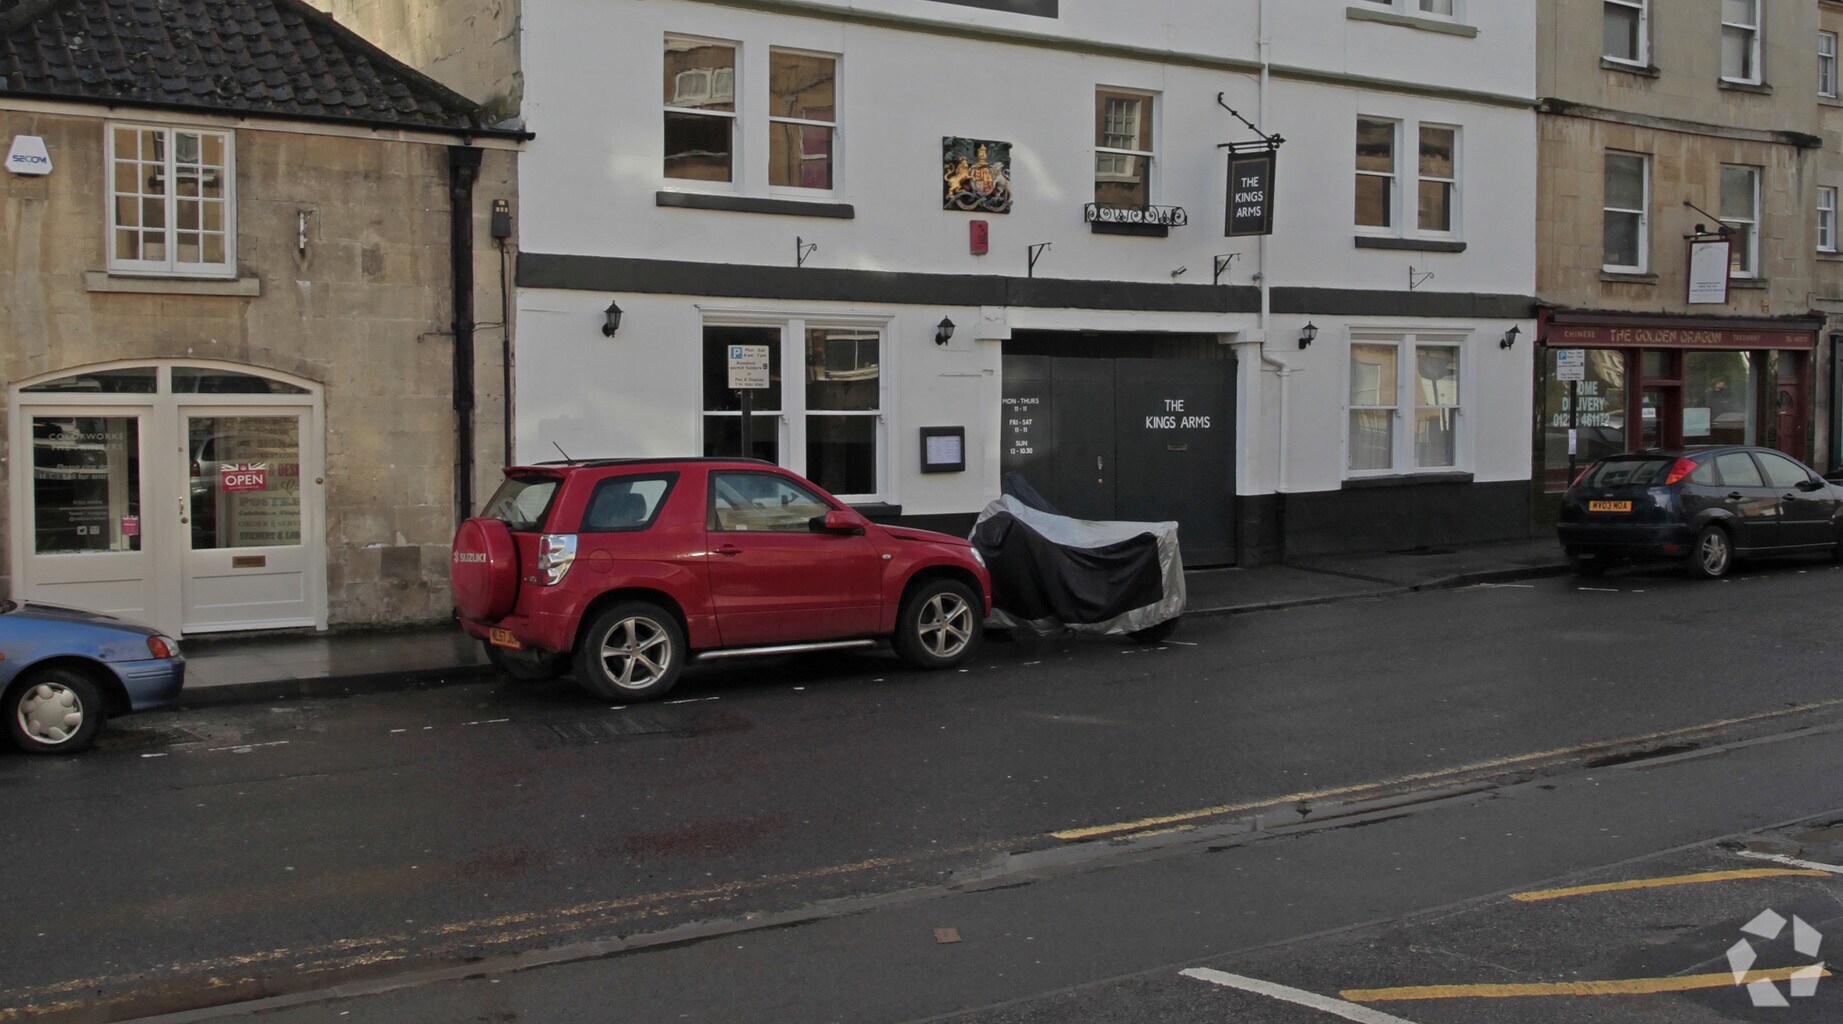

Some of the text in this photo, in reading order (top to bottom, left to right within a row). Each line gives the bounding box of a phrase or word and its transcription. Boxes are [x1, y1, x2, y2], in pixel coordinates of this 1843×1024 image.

[13, 154, 47, 164] SECOM
[1241, 176, 1260, 188] THE
[1235, 190, 1264, 203] KINGS
[1236, 206, 1262, 218] ARMS
[1564, 330, 1596, 338] CHINESE
[1610, 329, 1631, 342] THE
[1635, 329, 1677, 343] GOLDEN
[1680, 330, 1722, 343] DRAGON
[1576, 381, 1599, 396] OME
[1164, 399, 1185, 412] THE
[1561, 397, 1606, 411] DIVERY
[1145, 416, 1211, 429] KINGS ARMS
[1553, 413, 1579, 427] 012
[225, 473, 264, 486] OPEN
[460, 552, 487, 563] SUZUKI
